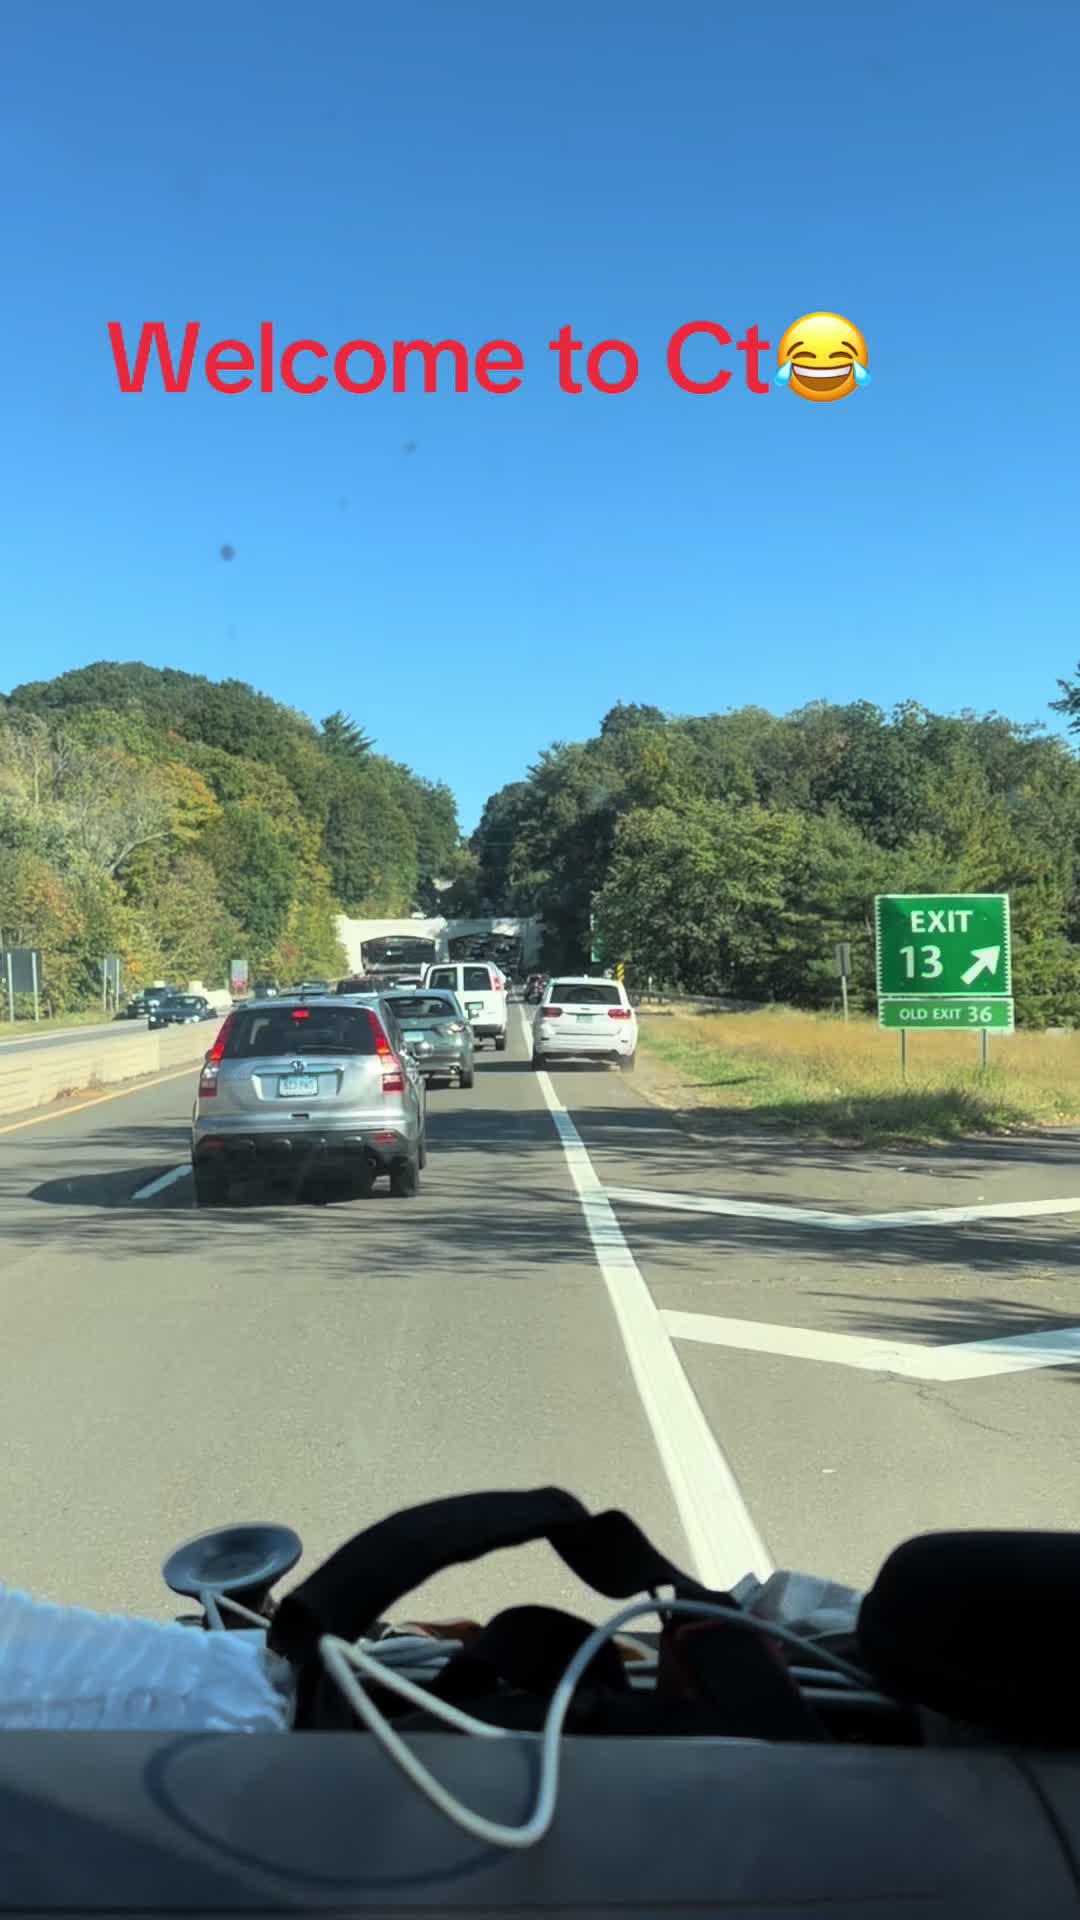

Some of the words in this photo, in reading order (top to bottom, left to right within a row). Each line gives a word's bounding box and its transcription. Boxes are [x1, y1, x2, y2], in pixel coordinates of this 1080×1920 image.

[910, 910, 973, 933] EXIT
[899, 945, 944, 979] 13
[899, 1008, 928, 1021] OLD
[933, 1008, 962, 1020] EXIT
[967, 1006, 993, 1023] 36
